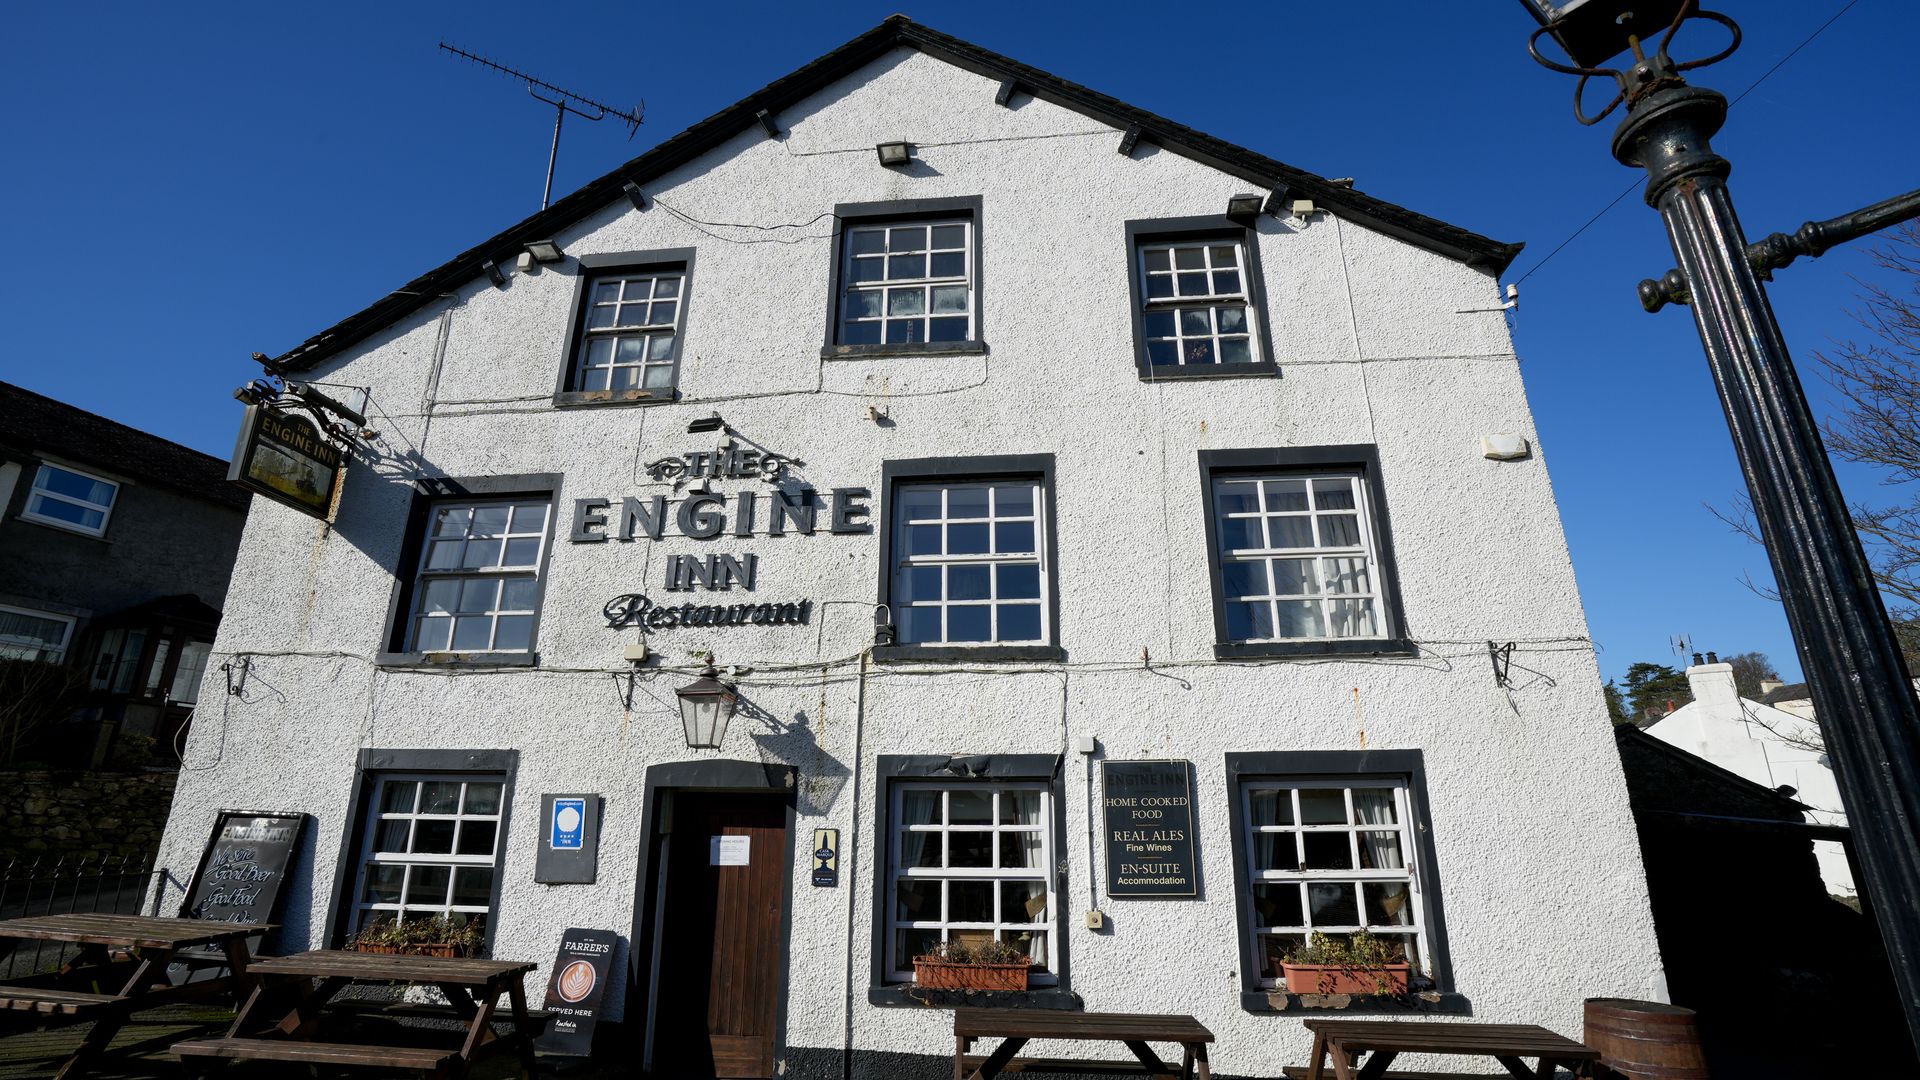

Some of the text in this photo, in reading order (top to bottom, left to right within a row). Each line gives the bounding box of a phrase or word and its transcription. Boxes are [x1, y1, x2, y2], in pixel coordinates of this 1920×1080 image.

[297, 423, 312, 437] THE
[262, 416, 337, 465] ENGINE INN
[683, 449, 762, 478] THE
[569, 486, 871, 543] ENGINE
[664, 553, 756, 591] INN
[603, 593, 812, 633] Restaurant
[1107, 773, 1185, 786] ENGINE INN
[1106, 797, 1188, 807] HOME COOKED
[1132, 810, 1163, 819] FOOD
[1114, 830, 1184, 842] REAL ALES
[1126, 843, 1173, 852] Fine Wines
[205, 864, 275, 886] Good Beer
[1120, 863, 1181, 874] EN-SUITE
[1117, 876, 1186, 885] Accommodation
[202, 884, 261, 911] Good Food
[564, 941, 609, 953] FARRER'S
[574, 1009, 593, 1017] HERE
